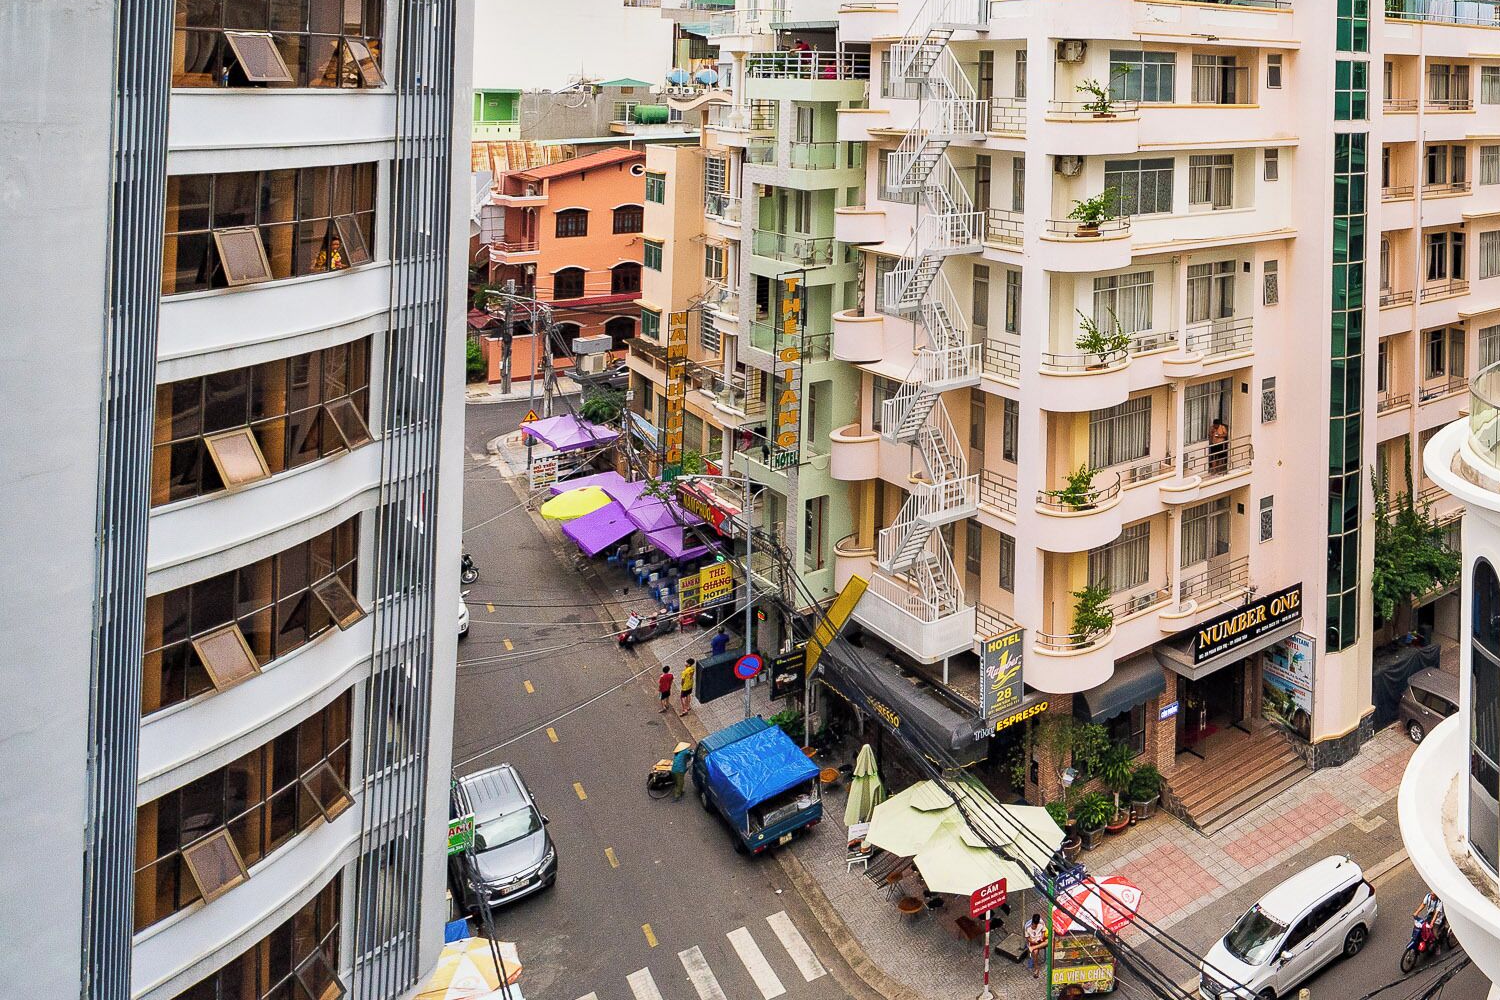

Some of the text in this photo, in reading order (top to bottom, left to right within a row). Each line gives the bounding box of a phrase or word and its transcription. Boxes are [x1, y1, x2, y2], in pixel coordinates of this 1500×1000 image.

[777, 347, 800, 447] GIANG
[775, 450, 799, 467] HOTEL
[703, 576, 731, 591] GIANG
[1199, 604, 1266, 649] NUMBER
[1270, 589, 1300, 616] ONE
[988, 633, 1021, 653] HOTEL
[996, 687, 1012, 702] 28
[996, 701, 1048, 732] ESPRESSO
